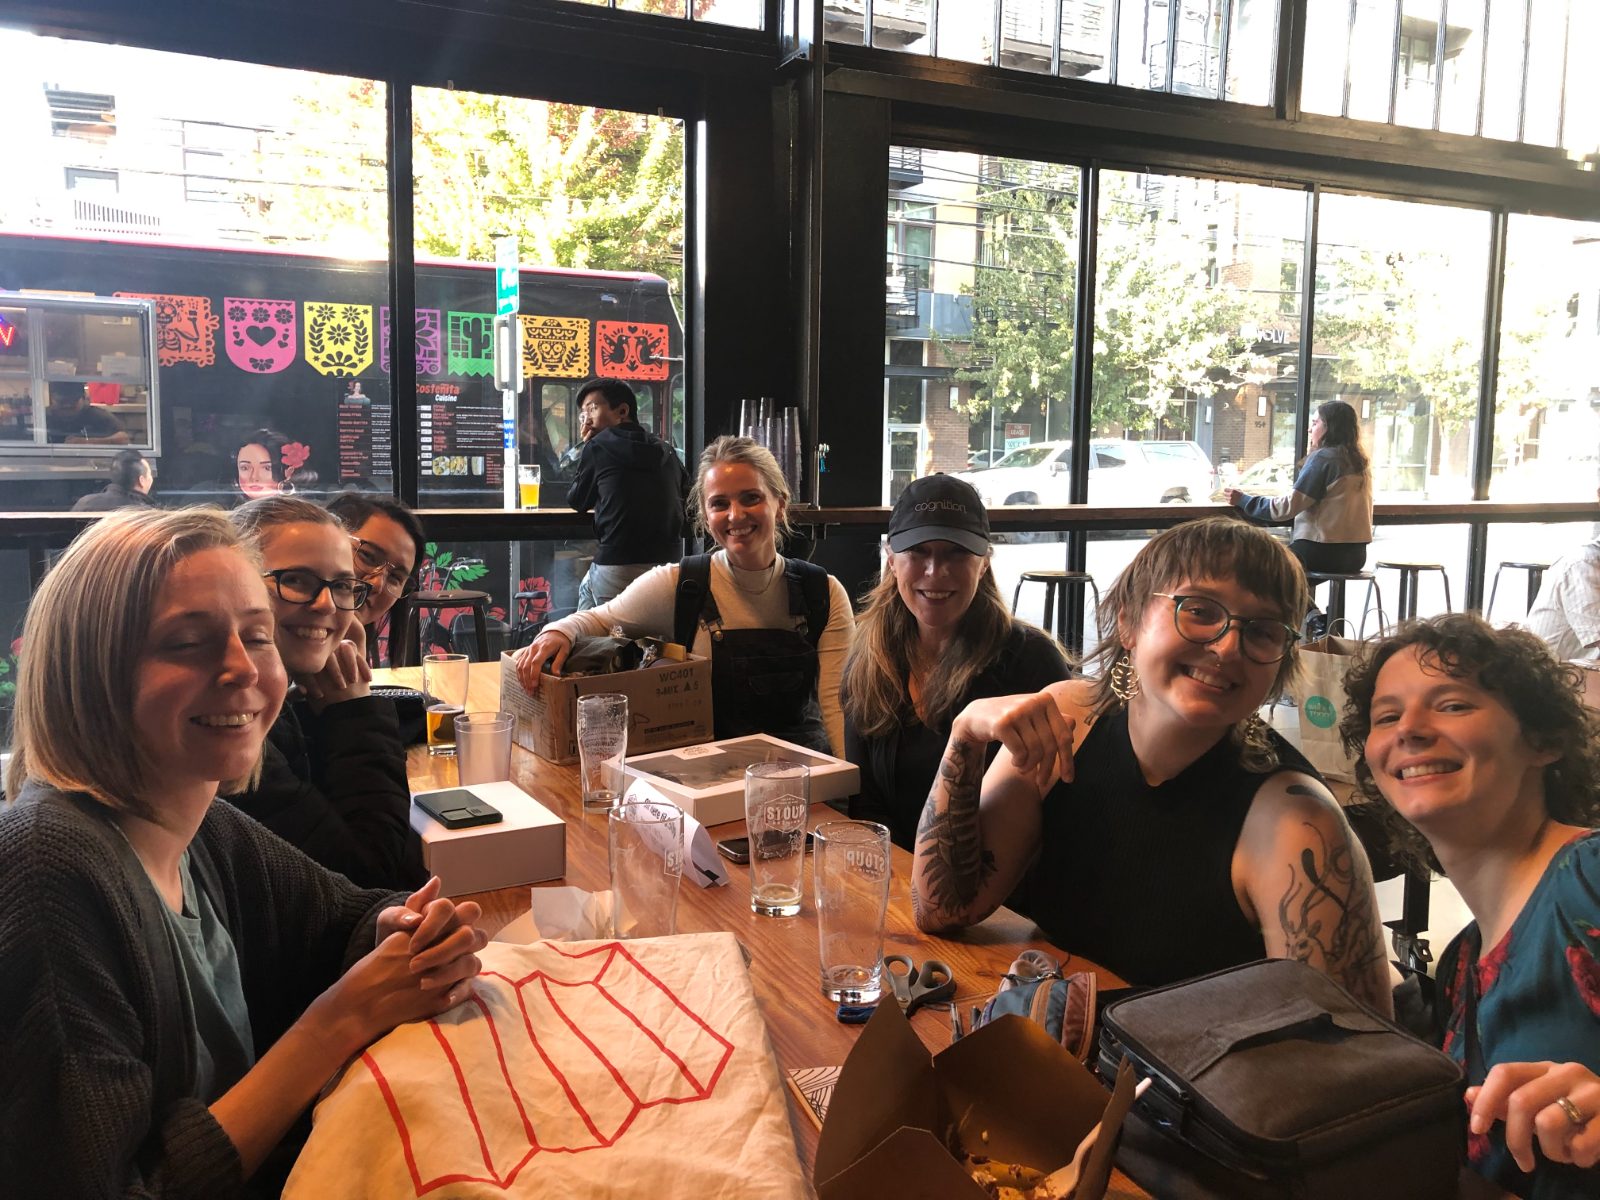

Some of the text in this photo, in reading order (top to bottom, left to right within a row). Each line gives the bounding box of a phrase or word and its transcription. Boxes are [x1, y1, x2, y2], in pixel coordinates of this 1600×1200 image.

[435, 394, 458, 402] Cuisine
[915, 499, 967, 514] cognition
[767, 804, 805, 821] STOUP
